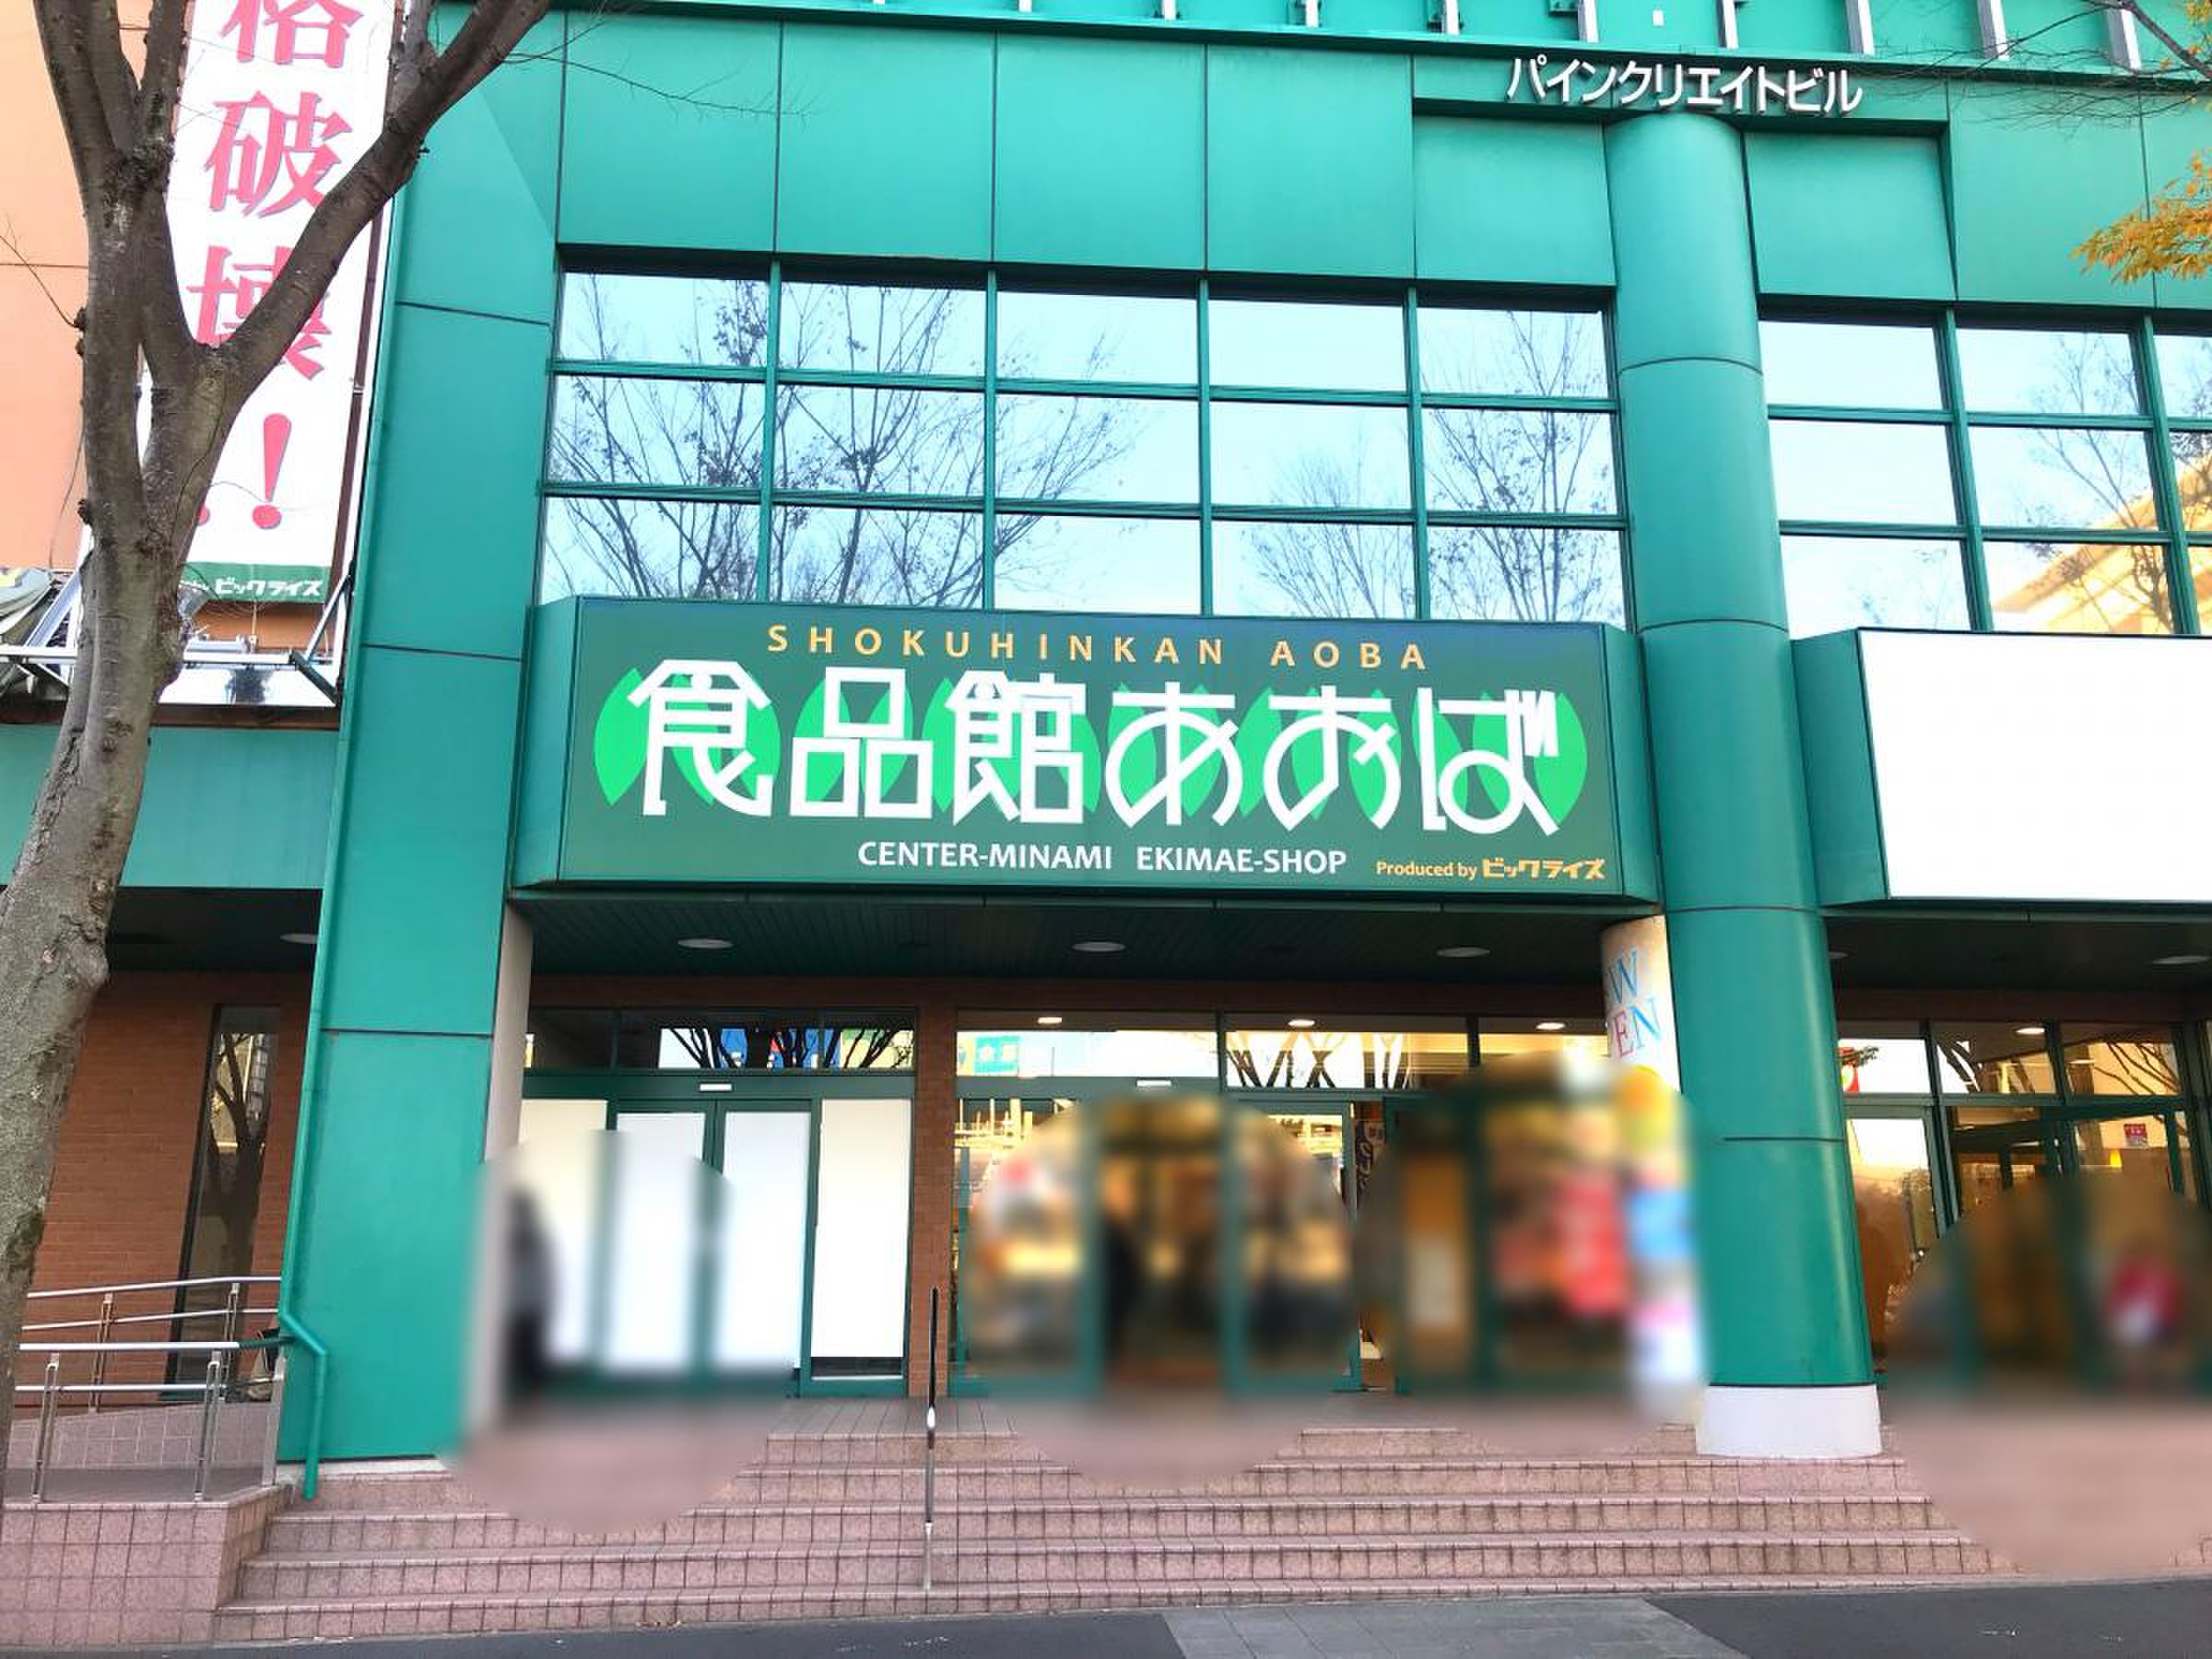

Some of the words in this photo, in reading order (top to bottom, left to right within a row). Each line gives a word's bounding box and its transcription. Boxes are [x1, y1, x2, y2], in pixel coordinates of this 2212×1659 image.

[1507, 53, 1864, 114] パインクリエイトビル
[767, 624, 1223, 665] SHOKUHINKAN
[1270, 641, 1426, 671] AOBA
[627, 658, 1560, 837] 食品館あおば
[857, 841, 1112, 869] CENTER-MINAMI
[1135, 846, 1347, 874] EKIMAE-SHOP
[1376, 860, 1454, 877] Produced
[1457, 860, 1477, 880] by
